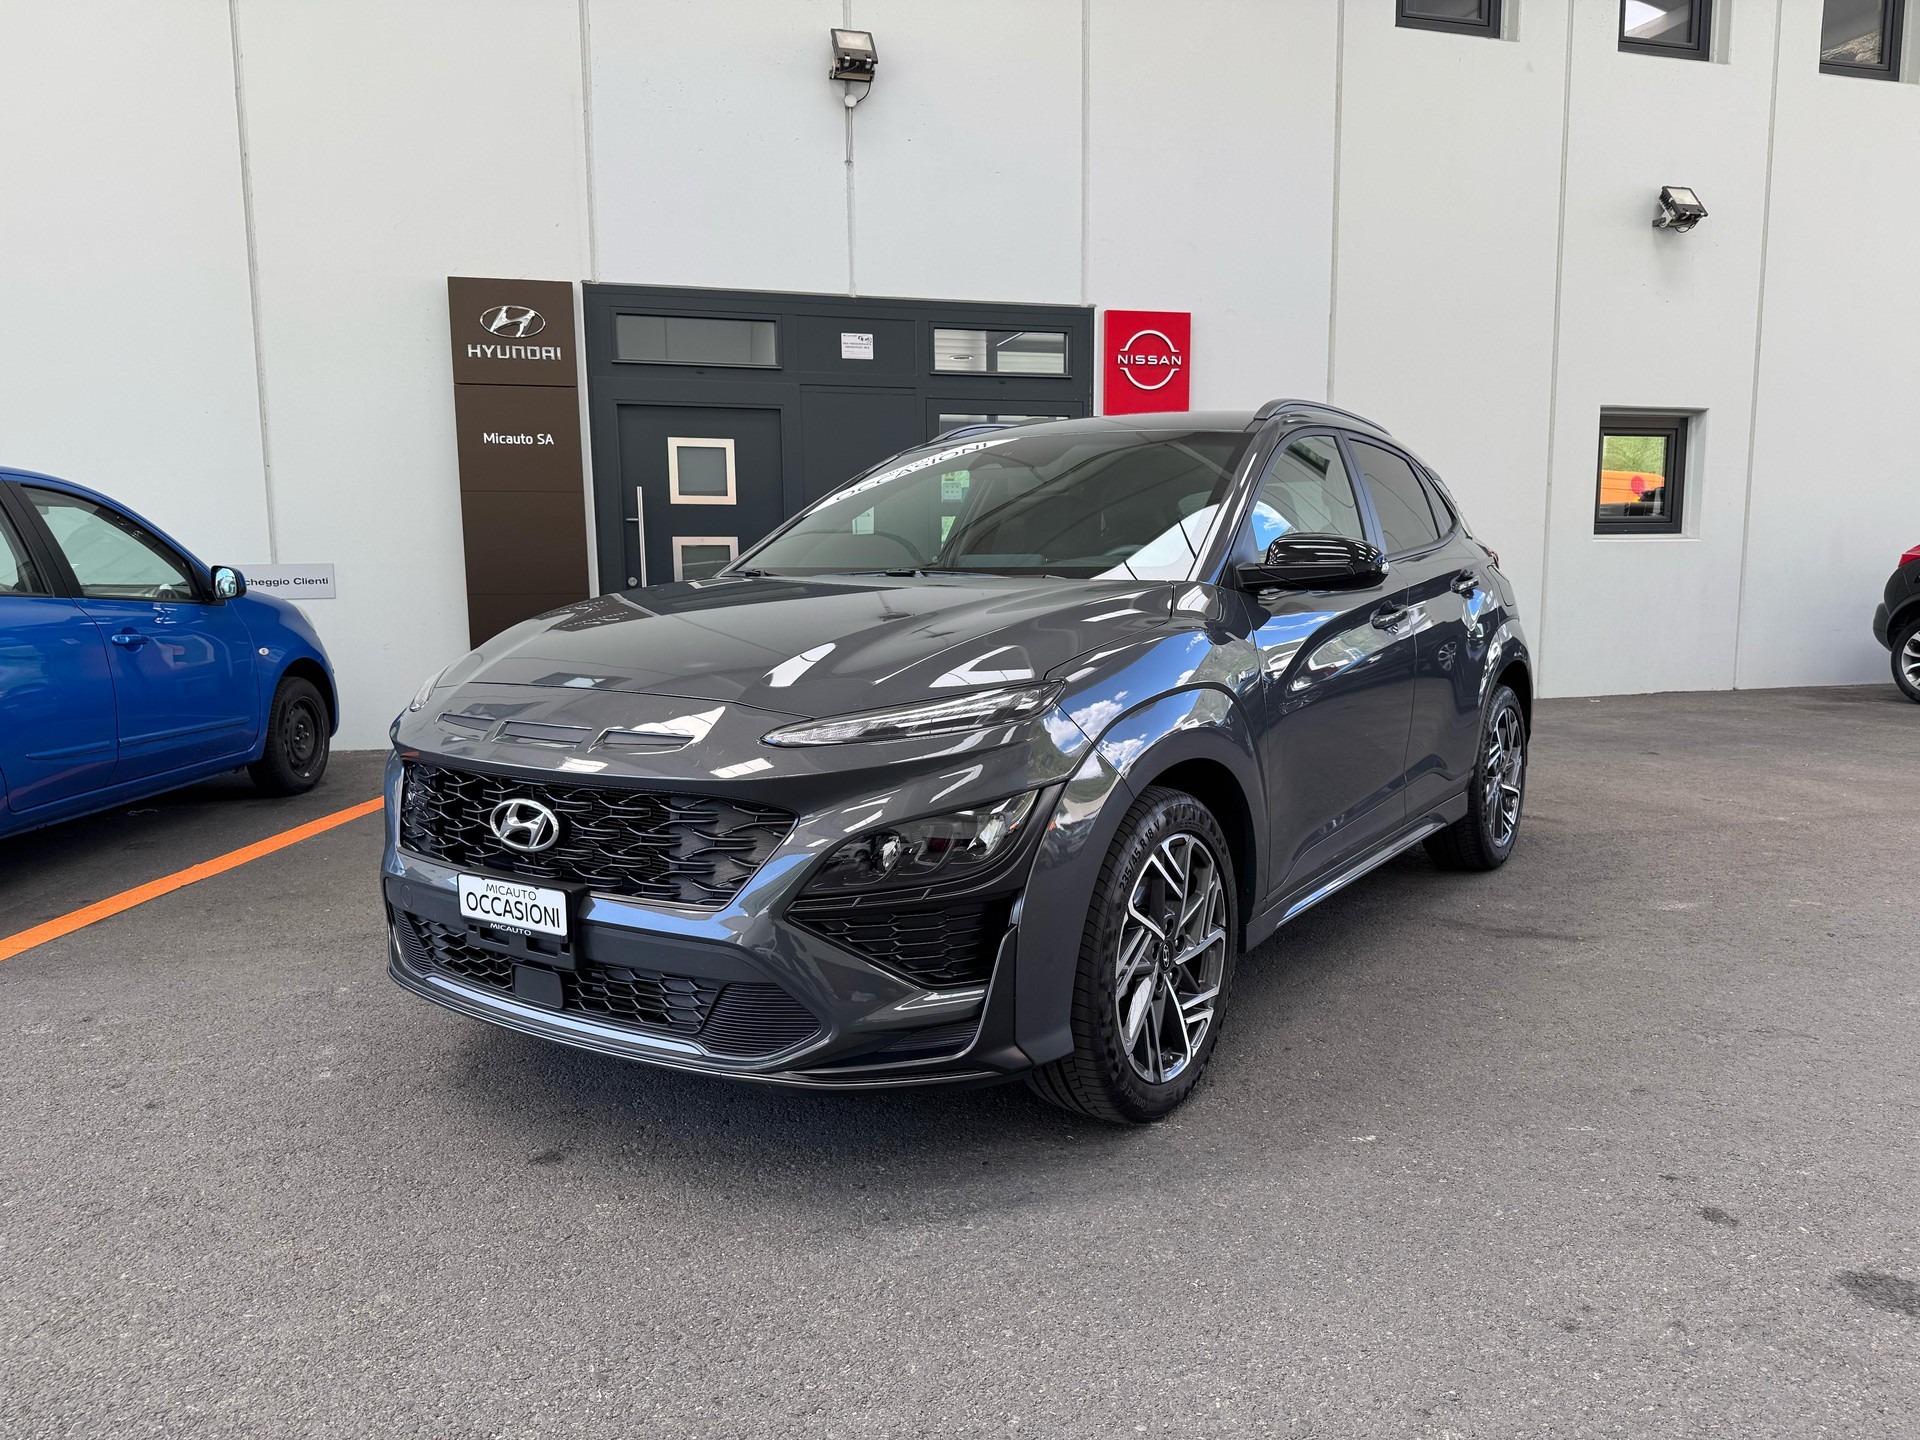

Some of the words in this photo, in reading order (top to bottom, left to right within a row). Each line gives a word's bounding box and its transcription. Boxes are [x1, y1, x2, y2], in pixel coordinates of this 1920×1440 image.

[467, 344, 561, 360] HYUNDAI
[1117, 354, 1182, 366] NISSAN
[483, 432, 533, 445] Micauto
[537, 433, 554, 445] SA
[293, 577, 329, 585] Clienti
[1119, 847, 1141, 892] 235/45
[1139, 838, 1147, 850] R
[1145, 828, 1154, 841] 18
[1153, 819, 1161, 831] V
[485, 883, 537, 901] MICAUTO
[466, 891, 560, 928] OCCASIONI
[490, 922, 532, 936] MICAUTO
